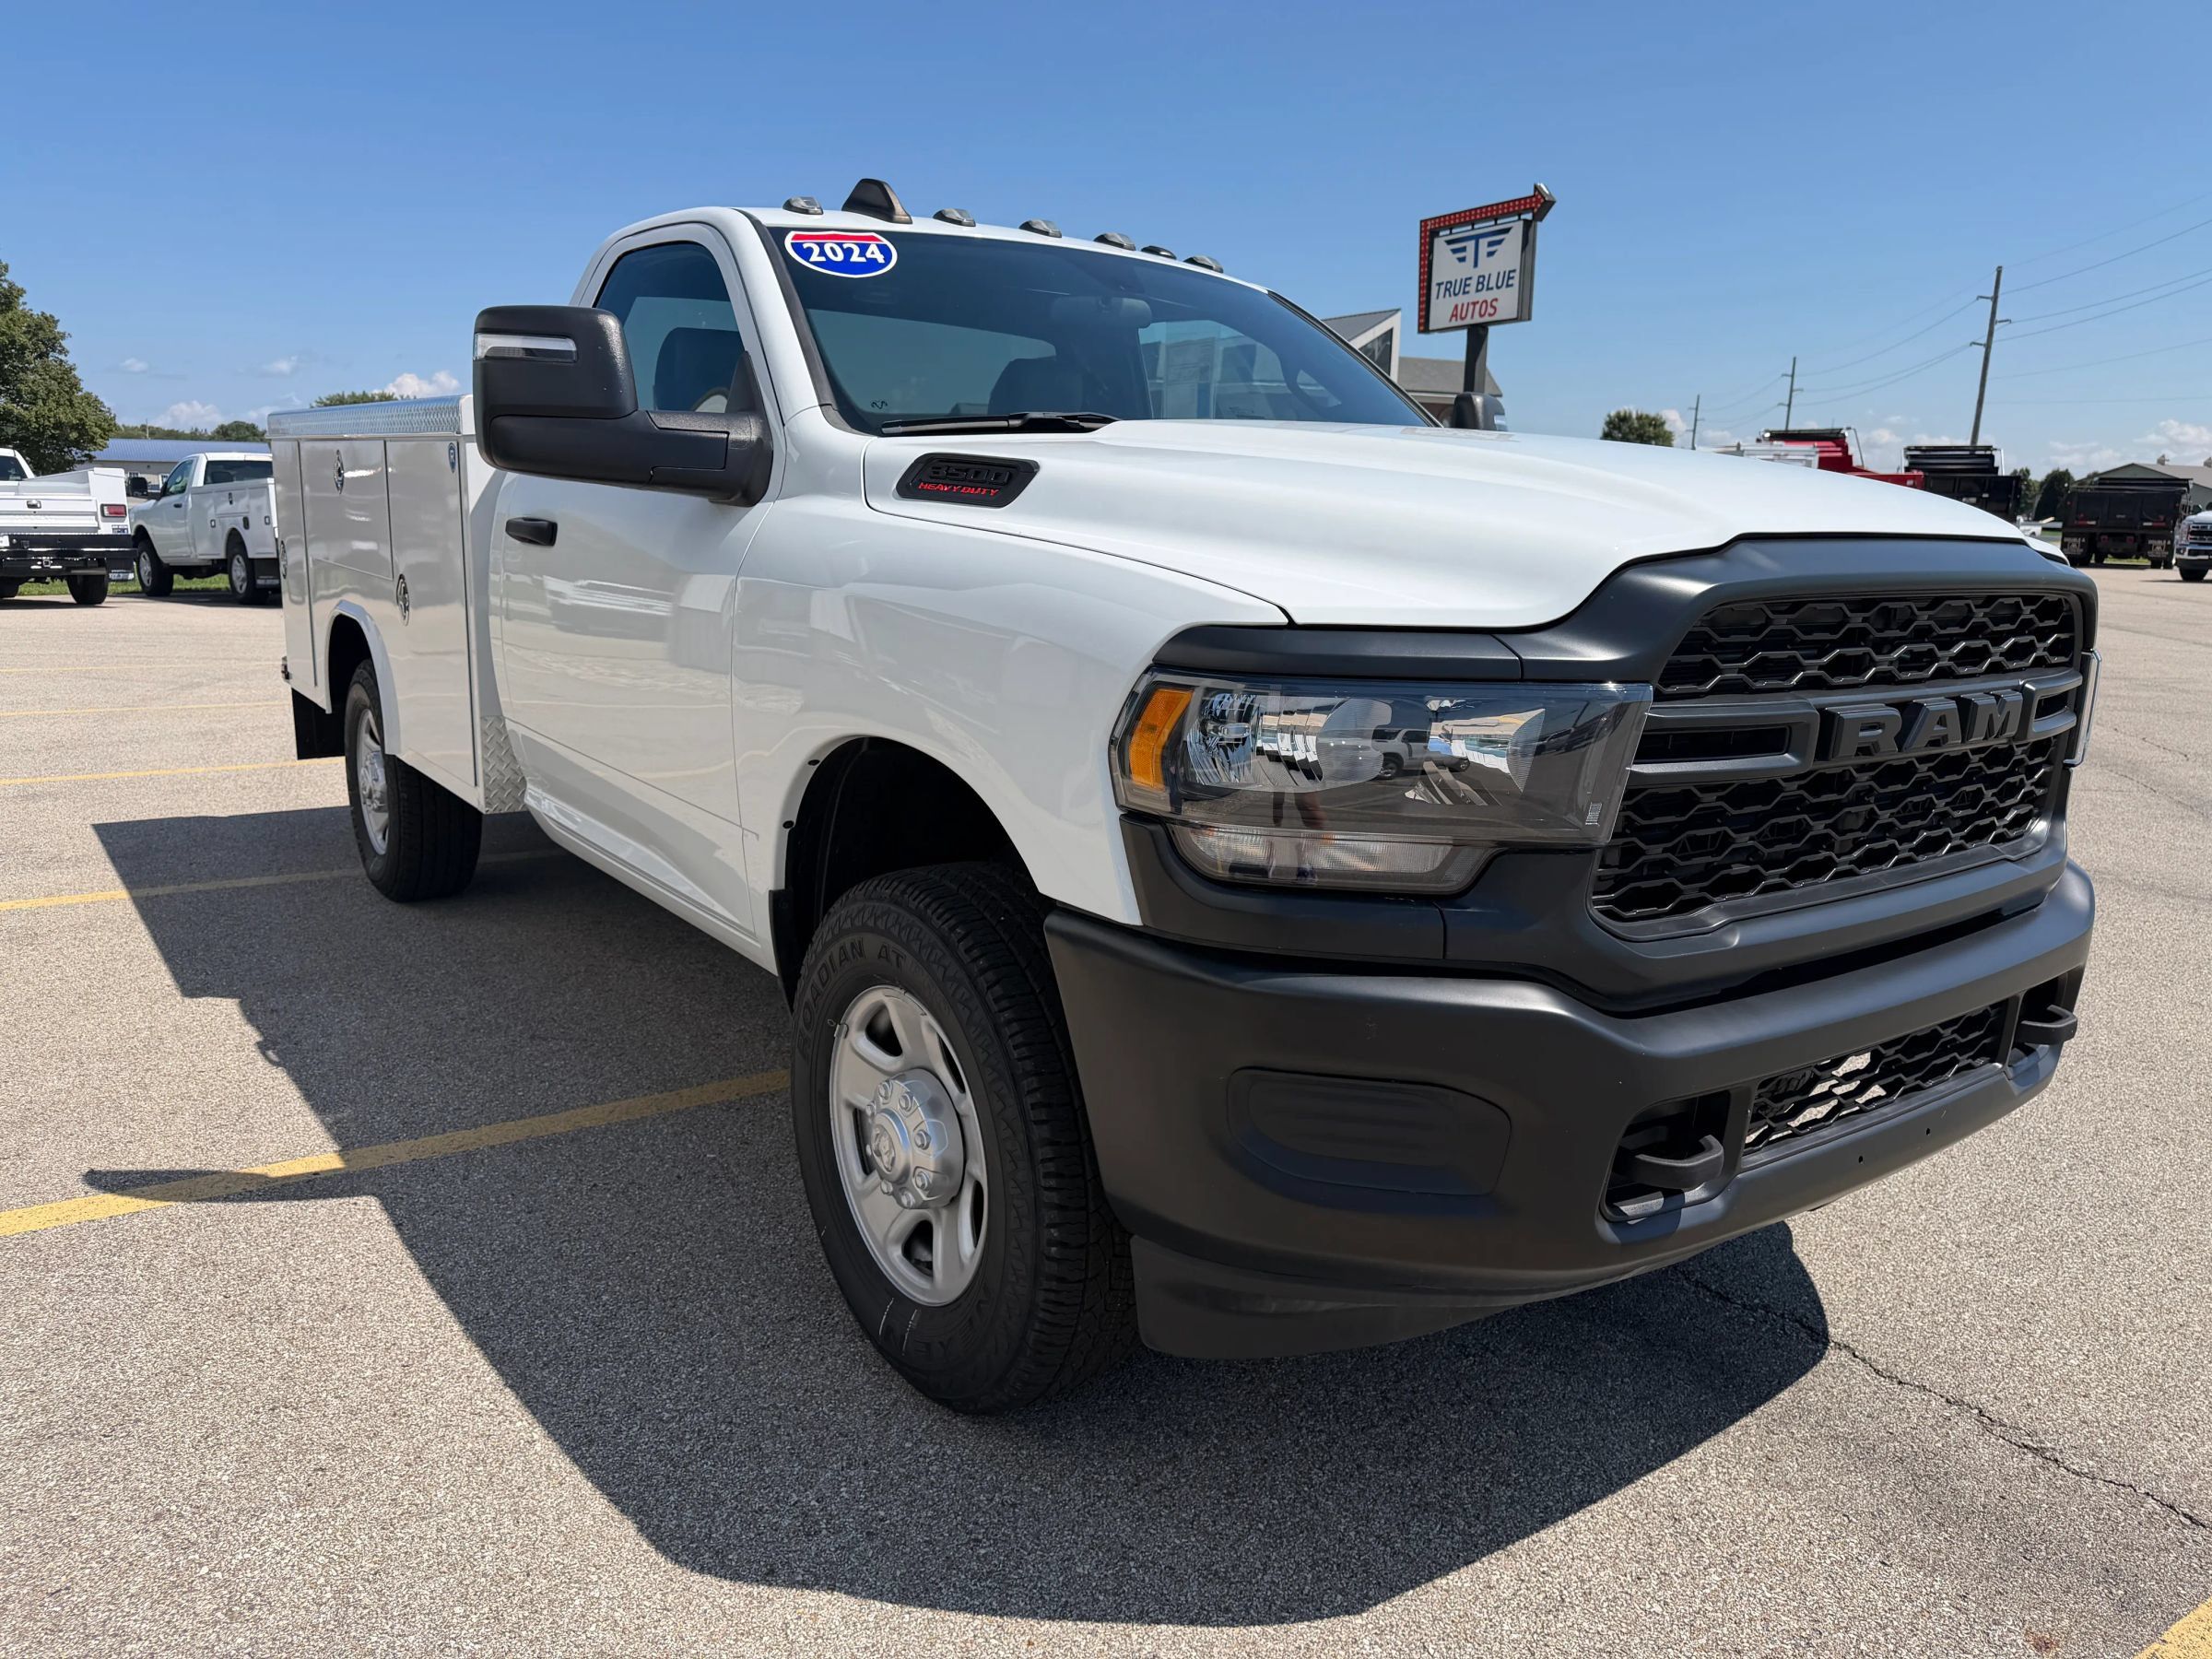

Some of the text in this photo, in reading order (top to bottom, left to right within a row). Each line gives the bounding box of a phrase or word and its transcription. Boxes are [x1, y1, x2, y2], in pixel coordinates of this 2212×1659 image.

[803, 242, 886, 264] 2024
[1435, 269, 1517, 300] TRUE BLUE
[1449, 298, 1499, 323] AUTOS
[929, 465, 1012, 486] 3500
[918, 482, 1000, 497] HEAVY DUTY
[1827, 691, 2023, 758] RAM
[797, 937, 865, 1065] ROADIAN
[877, 942, 907, 970] AT
